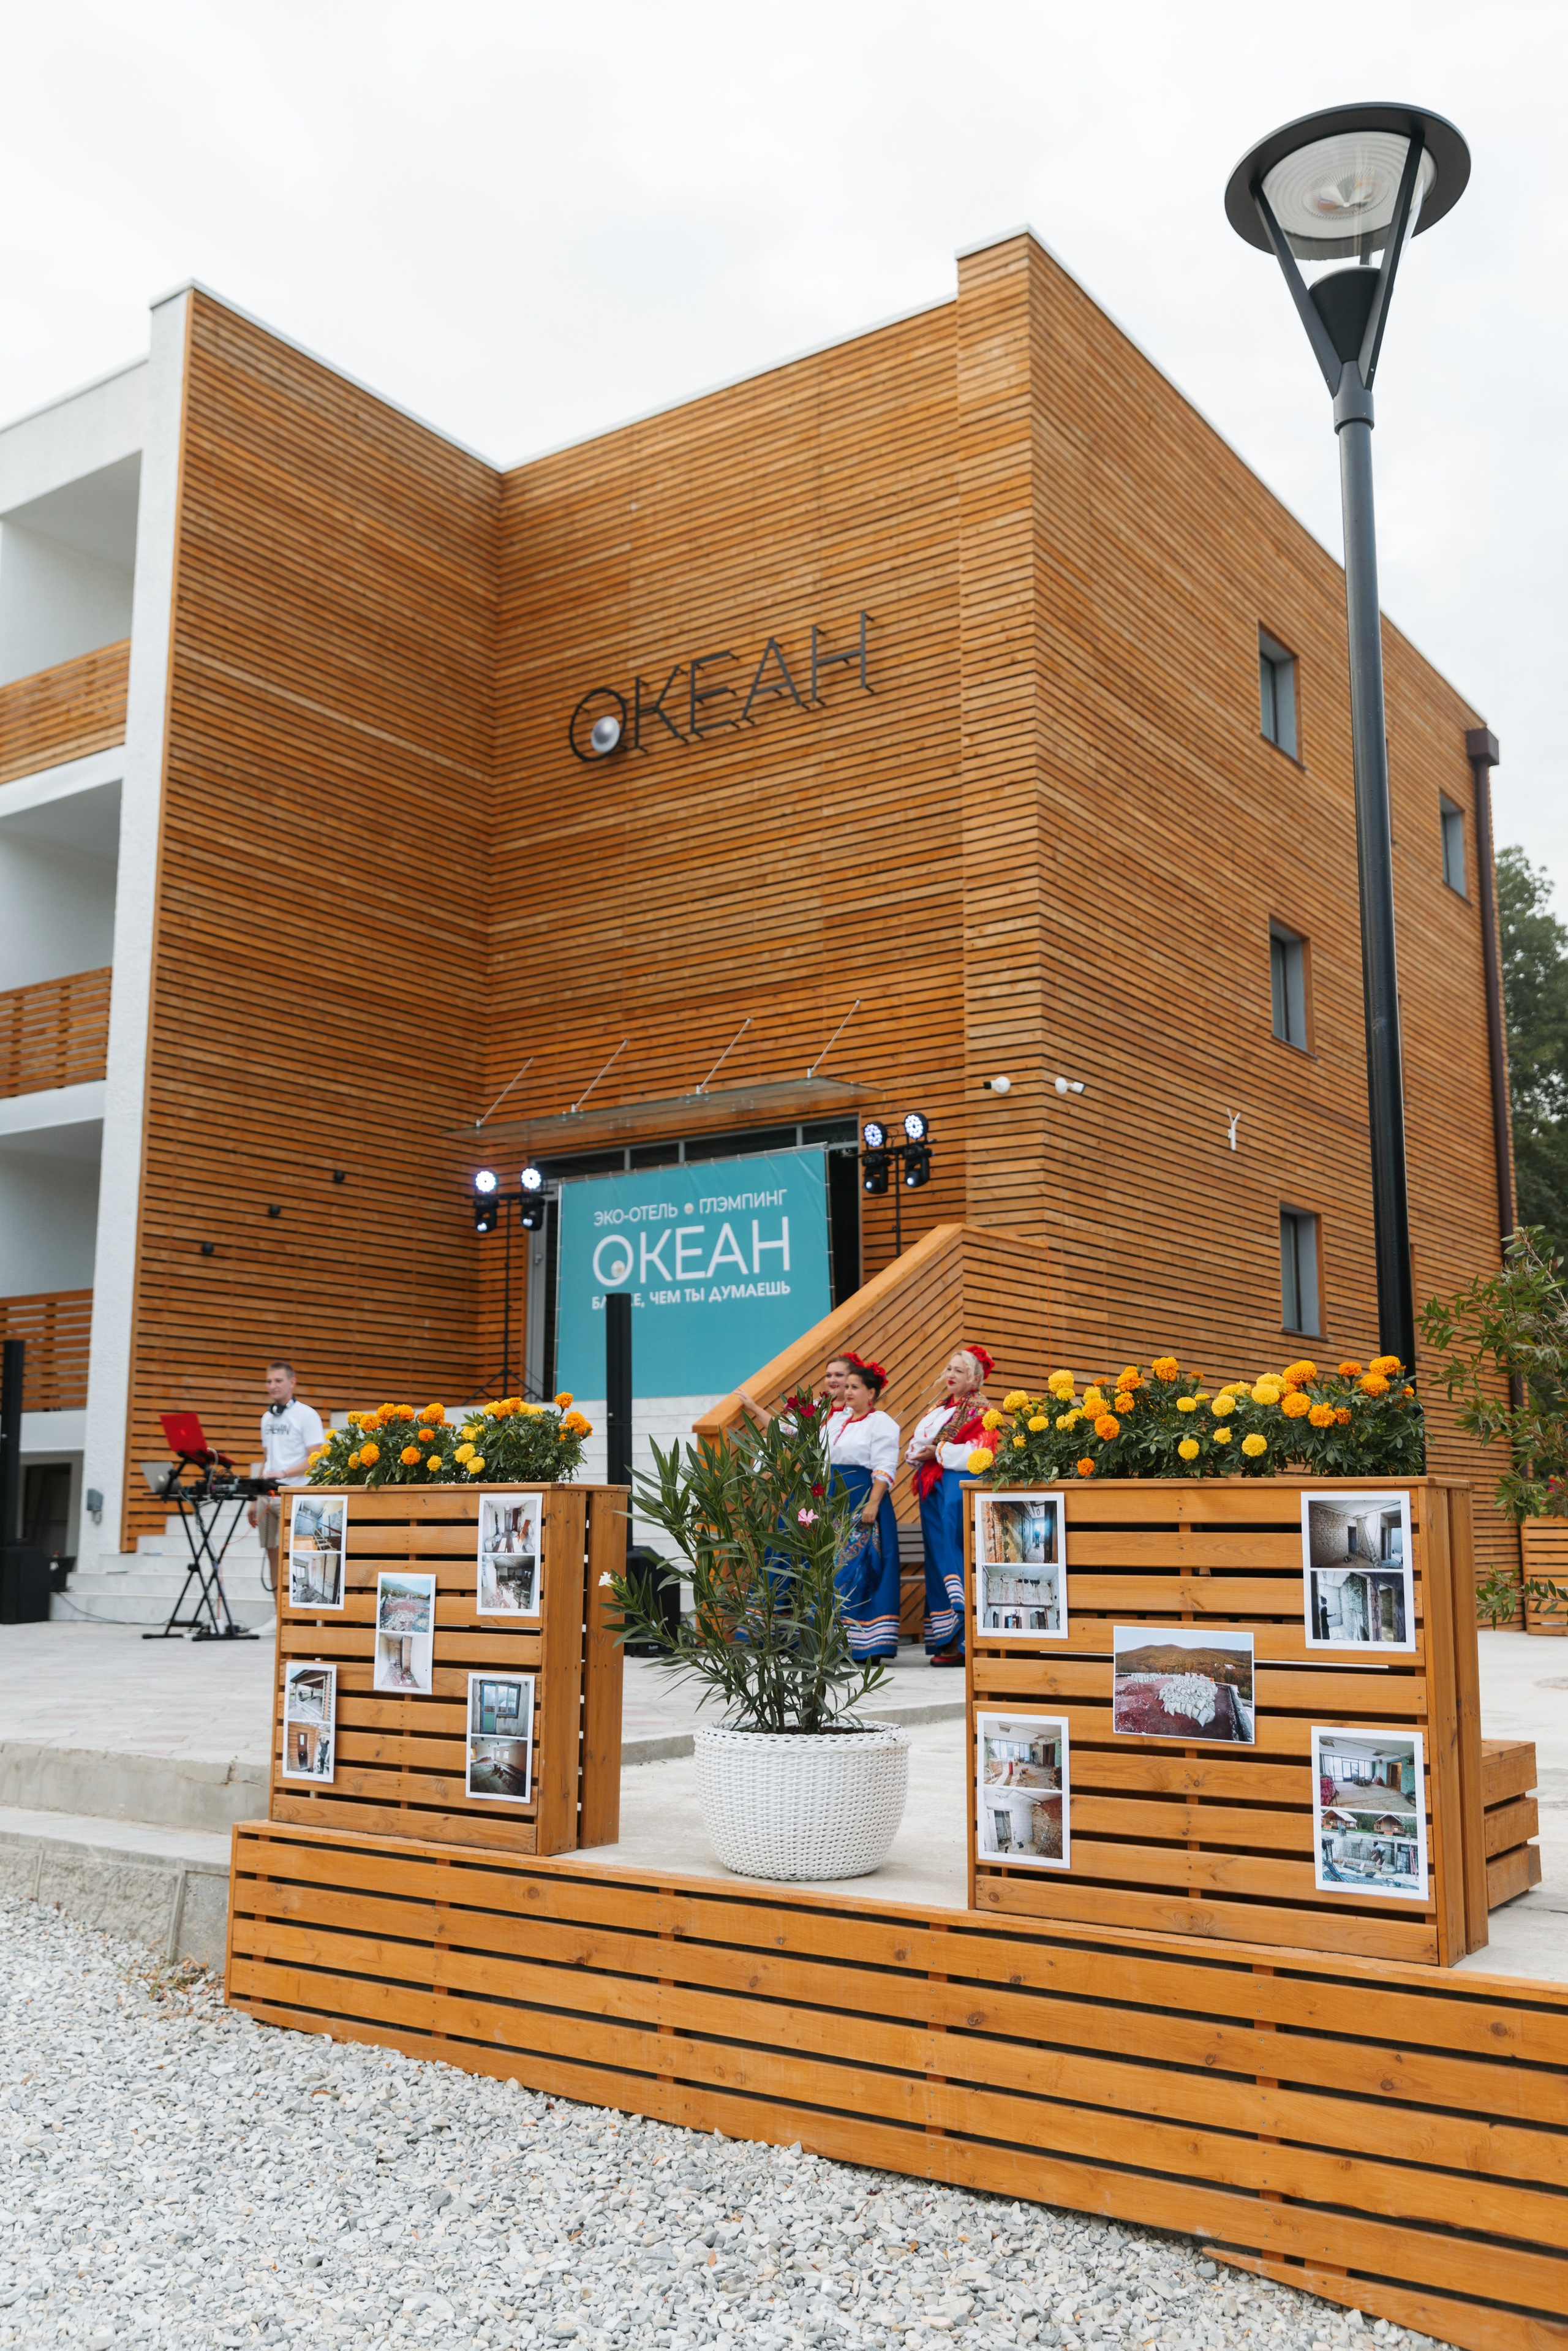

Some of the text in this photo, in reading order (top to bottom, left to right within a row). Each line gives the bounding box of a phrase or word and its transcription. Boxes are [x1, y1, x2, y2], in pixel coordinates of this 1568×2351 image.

[569, 610, 870, 762] ОКЕАН
[594, 1190, 788, 1226] ЭКО-ОТЕЛЬ ГЛЭМПИНГ
[592, 1216, 791, 1286] ОКЕАН
[649, 1289, 681, 1305] ЧЕМ
[684, 1288, 704, 1302] ТЫ
[709, 1281, 791, 1301] ДУМАЕШЬ
